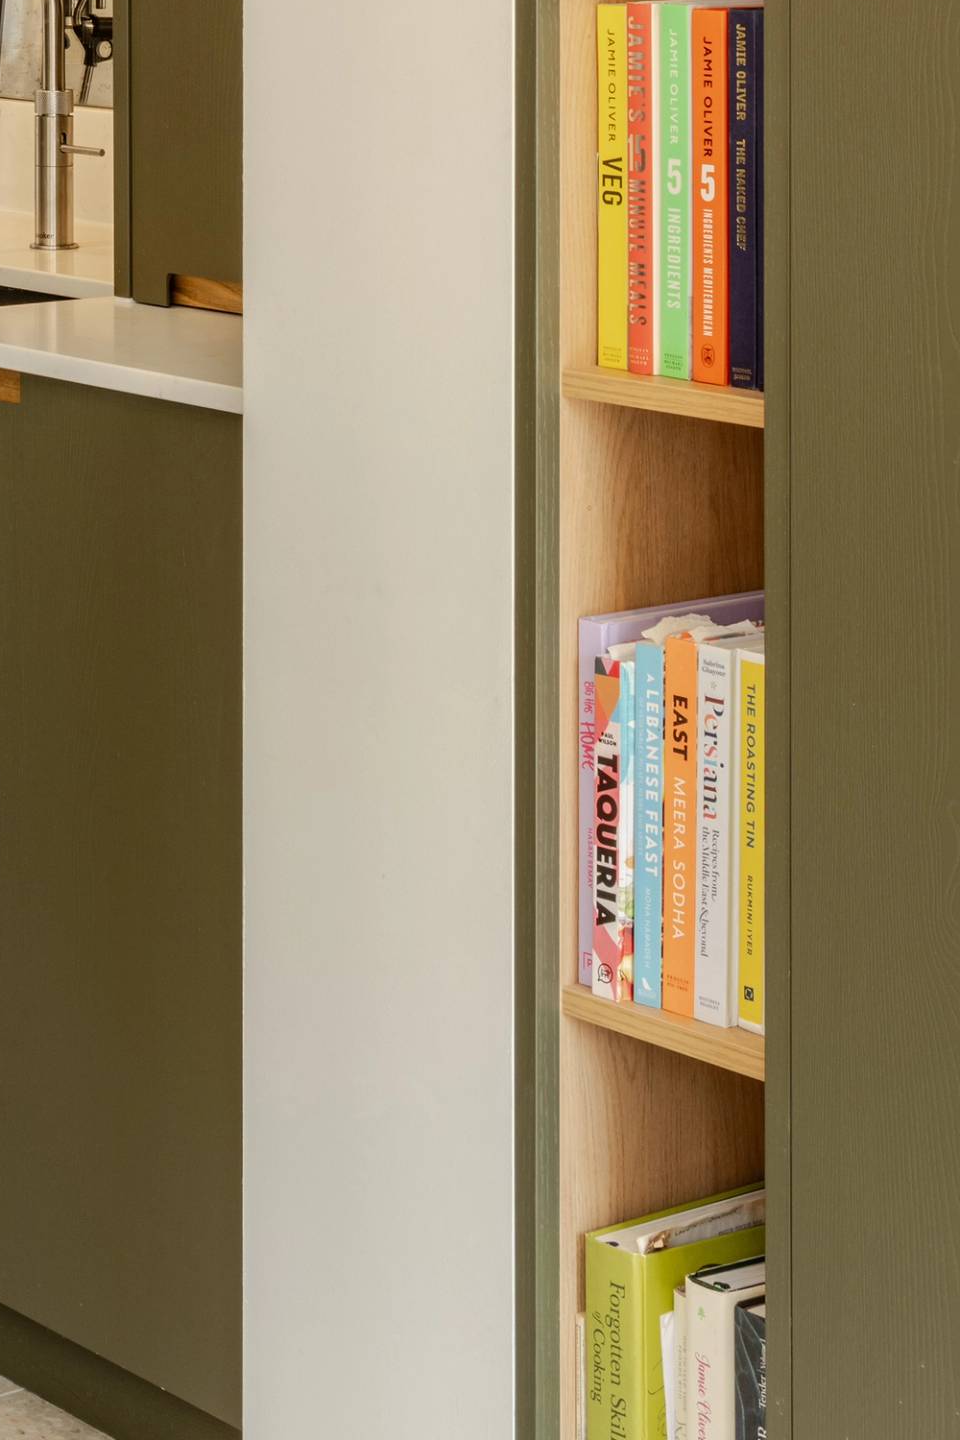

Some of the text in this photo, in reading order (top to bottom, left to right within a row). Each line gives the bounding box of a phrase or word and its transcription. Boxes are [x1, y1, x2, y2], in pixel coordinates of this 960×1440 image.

[607, 28, 617, 143] JAMIE OLIVER
[669, 29, 679, 144] JAMIE OLIVER
[703, 36, 713, 157] JAMIE OLIVER
[736, 24, 747, 121] JAMIE OLIVER
[601, 156, 623, 206] VEG
[736, 139, 747, 251] THE NAKED CHEF
[667, 159, 682, 309] 5 INGREDIENTS
[700, 163, 716, 337] 5 INGREDIENTS MEDITERRANEAN
[629, 262, 647, 326] MEALS
[579, 721, 595, 771] HOME
[645, 674, 660, 877] A LEBANESE FEAST
[703, 695, 726, 821] Persiana
[746, 685, 756, 848] THE ROASTING TIN
[596, 754, 618, 926] TAQUERIA
[672, 694, 689, 940] EAST MEERA SODHA
[701, 826, 710, 844] the
[701, 845, 710, 882] Middle
[711, 829, 720, 902] Recipes from
[699, 919, 709, 957] beyond
[701, 884, 709, 906] East
[746, 874, 754, 925] RUKMINI
[591, 1311, 605, 1405] of Cooking
[604, 1280, 628, 1440] Forgotten Skil
[695, 1352, 711, 1397] Jamie
